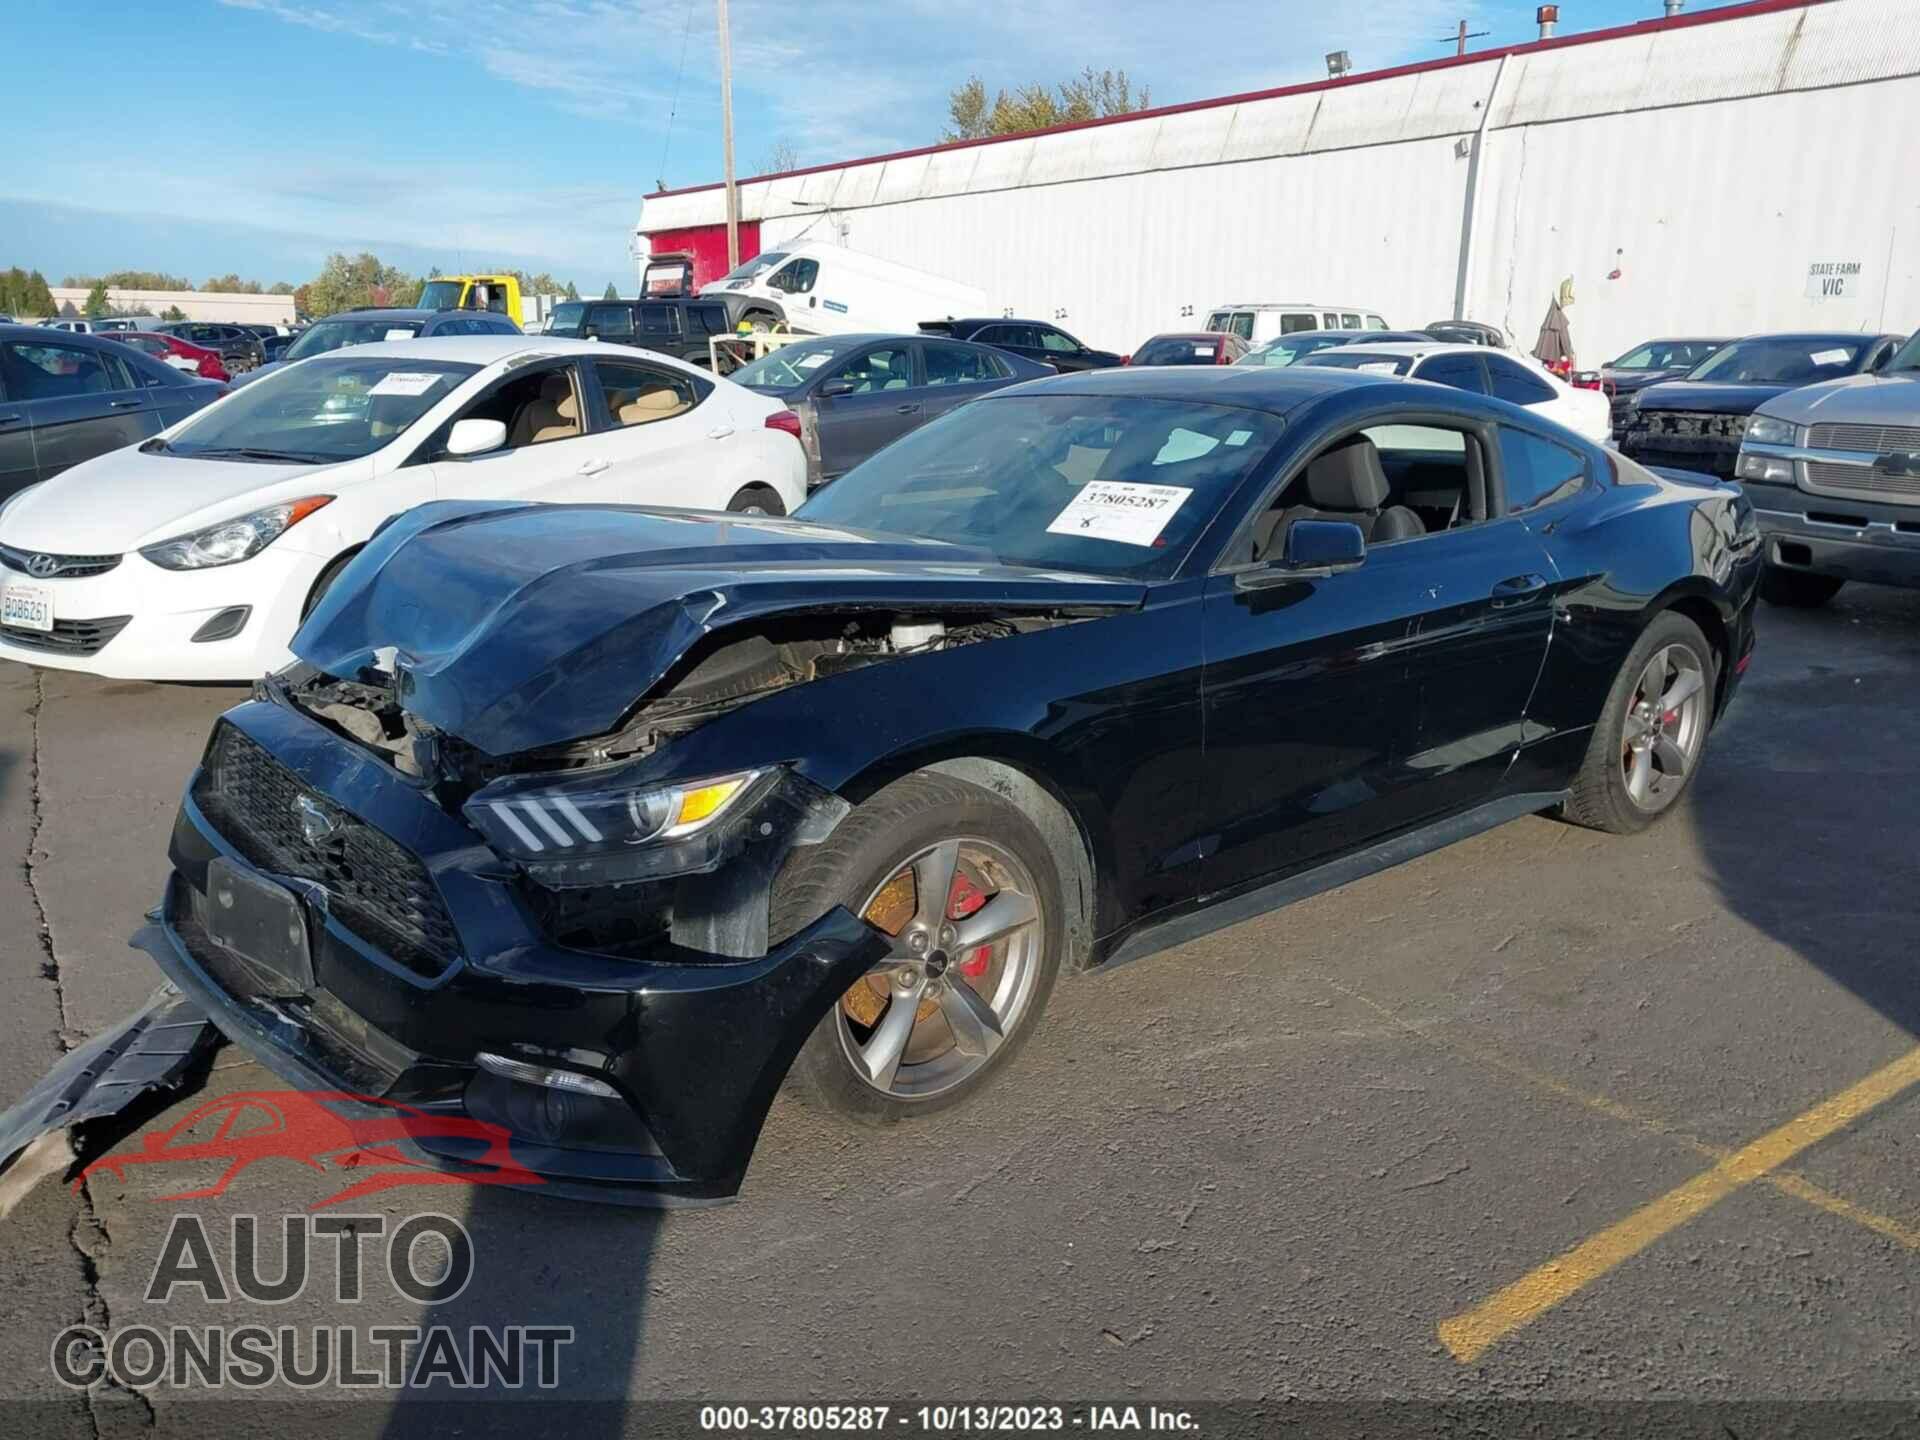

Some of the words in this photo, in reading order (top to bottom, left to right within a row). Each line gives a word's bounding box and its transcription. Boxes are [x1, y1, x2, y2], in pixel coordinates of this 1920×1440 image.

[1809, 263, 1834, 276] STATE
[1835, 263, 1861, 275] FARM
[1822, 278, 1844, 296] VIC
[1082, 492, 1169, 510] 37805287
[4, 597, 48, 621] BQB6261
